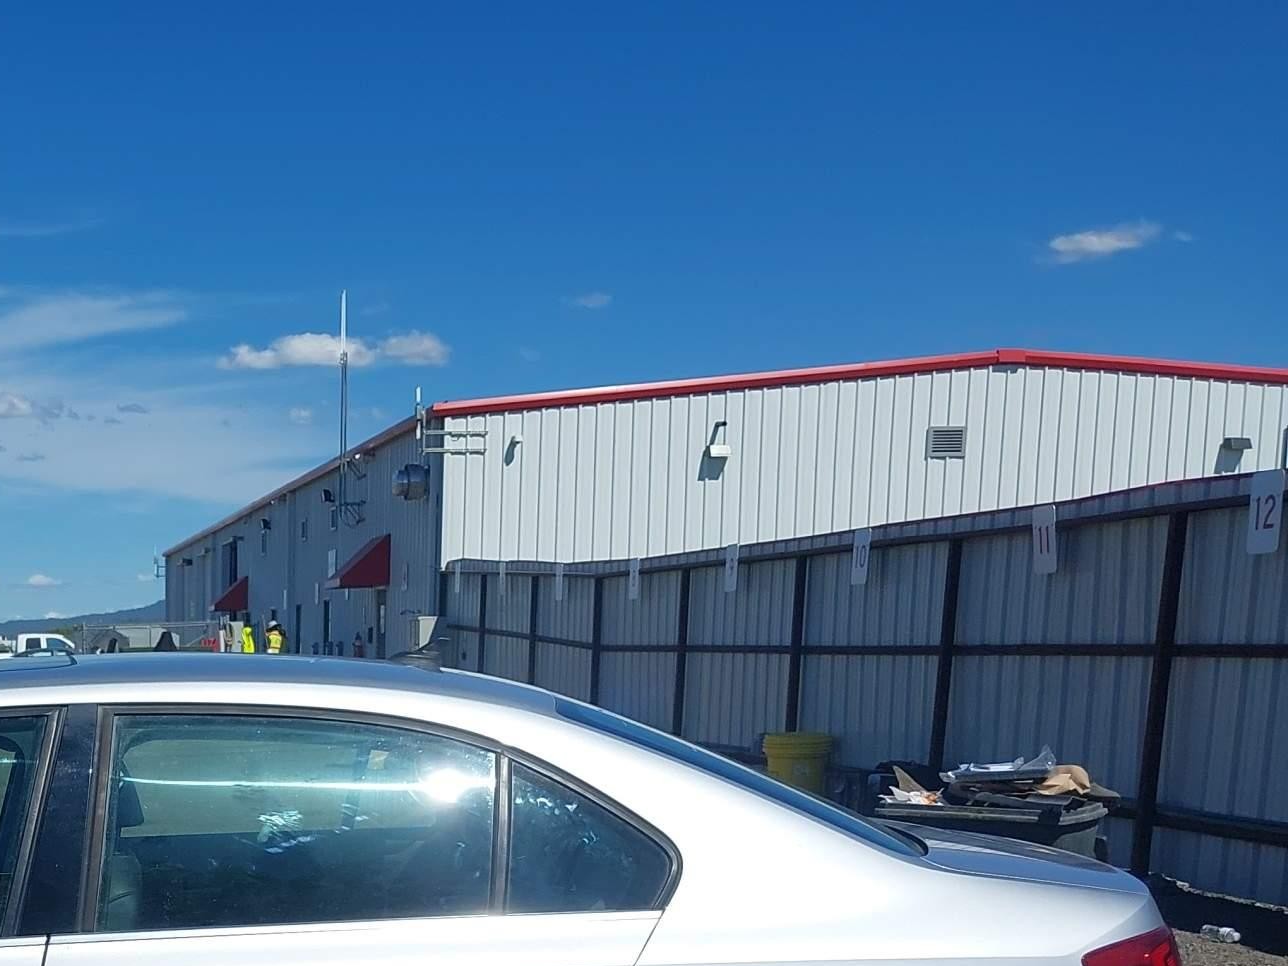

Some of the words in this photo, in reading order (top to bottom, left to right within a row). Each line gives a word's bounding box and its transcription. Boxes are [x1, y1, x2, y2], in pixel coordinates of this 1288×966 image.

[1255, 495, 1276, 530] 12
[1038, 526, 1050, 554] 11
[855, 544, 867, 569] 10
